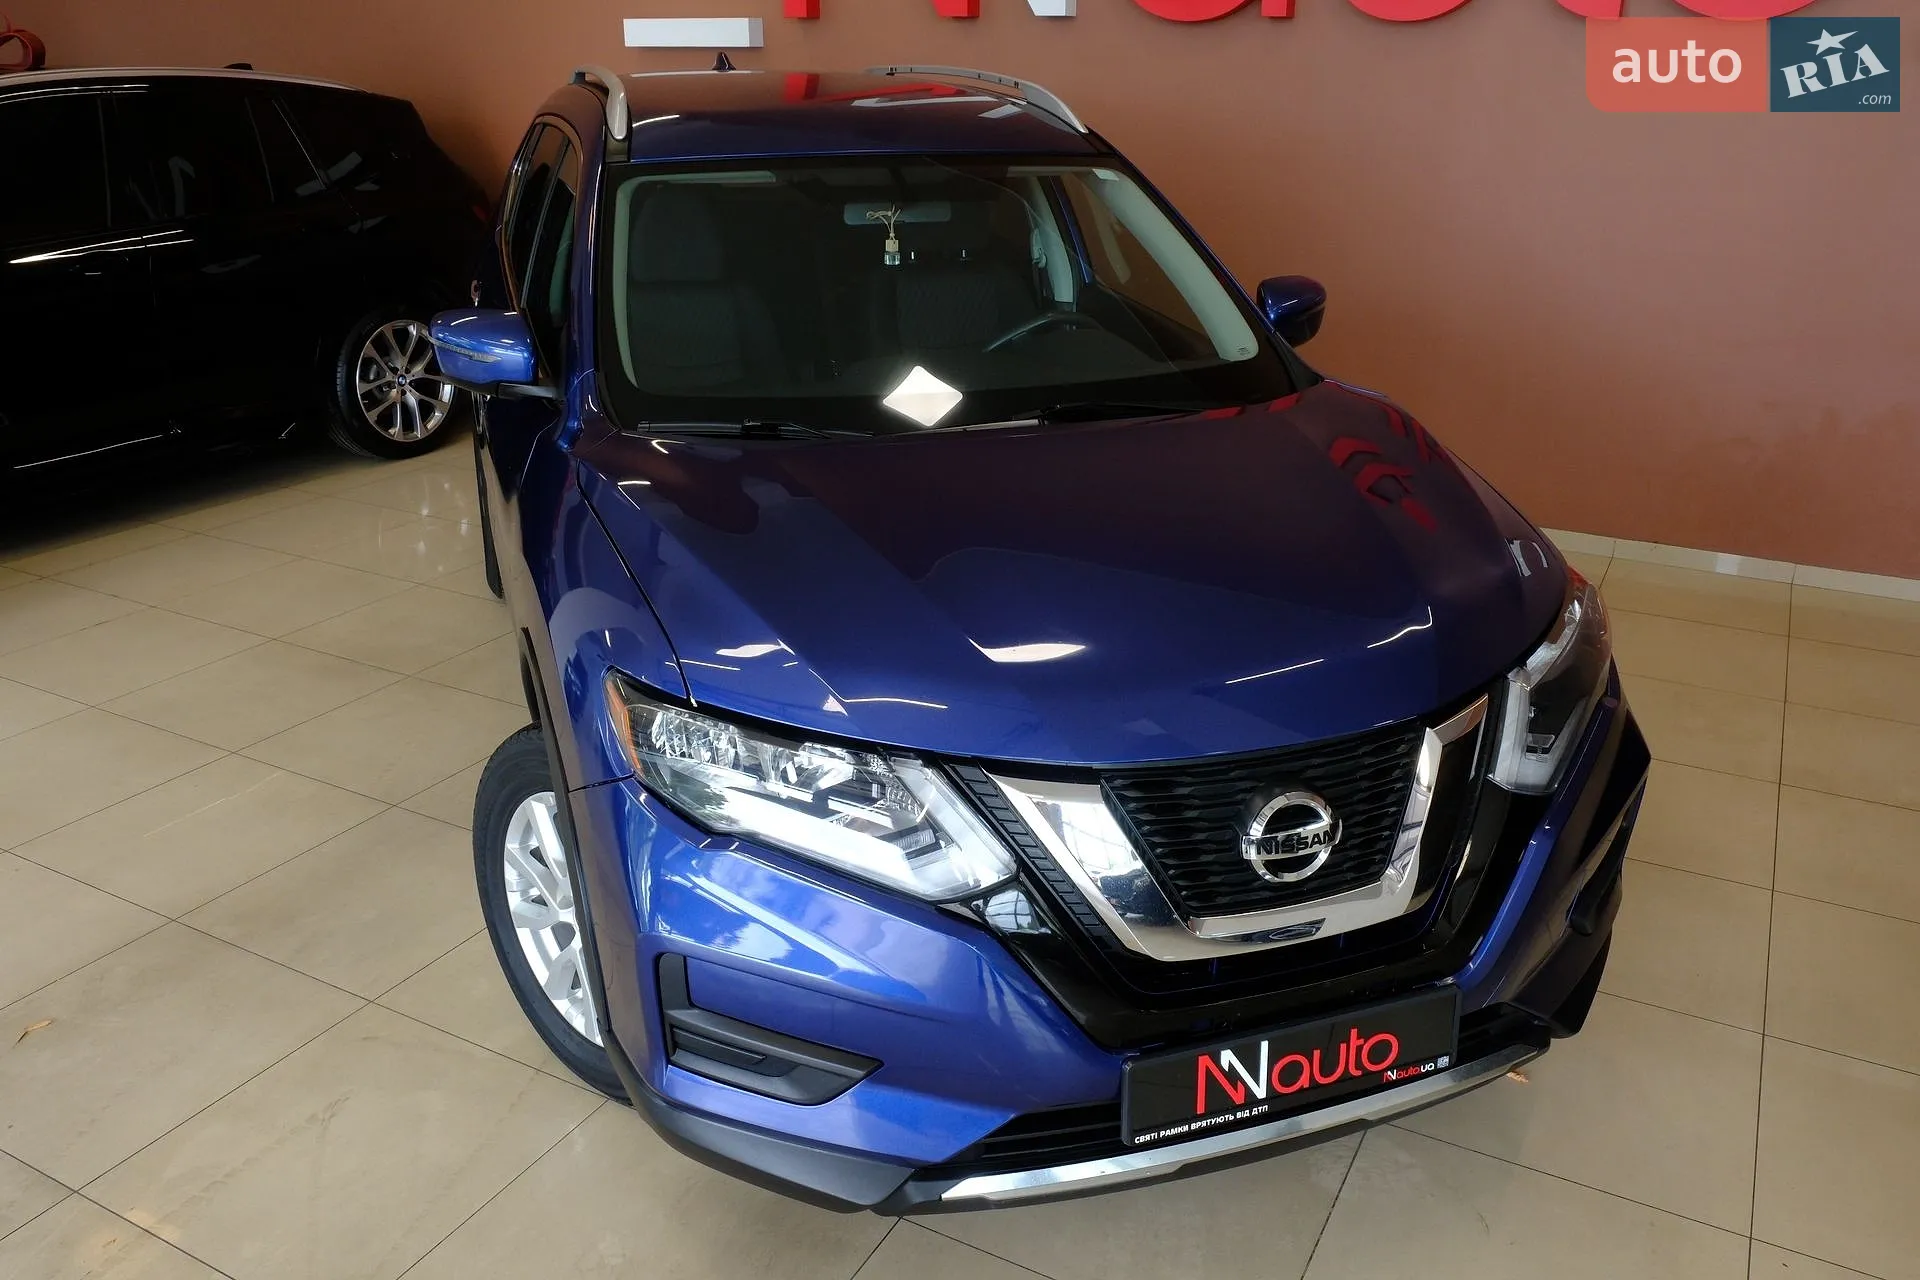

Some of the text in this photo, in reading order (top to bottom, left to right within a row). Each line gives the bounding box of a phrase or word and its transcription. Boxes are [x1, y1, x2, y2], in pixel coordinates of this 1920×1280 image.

[1256, 829, 1336, 856] NISSAN
[1134, 1105, 1269, 1144] СВЯТІ РАМКИ ВРЯТУЮТЬ ВІД ДТП
